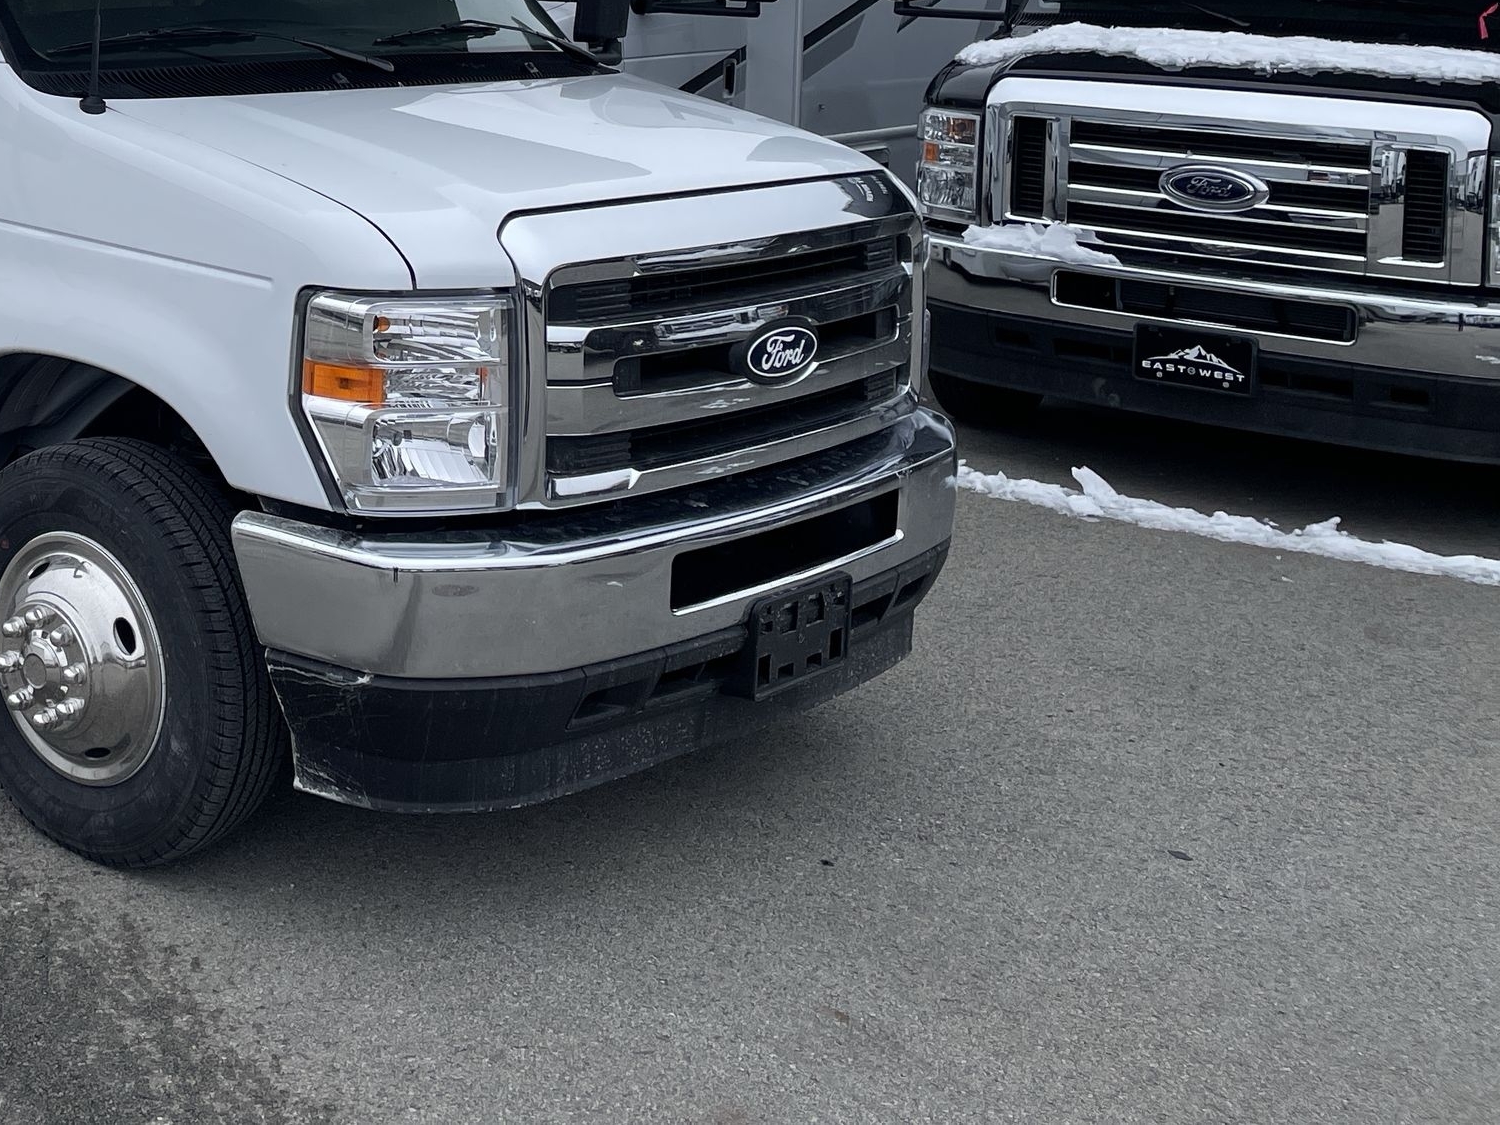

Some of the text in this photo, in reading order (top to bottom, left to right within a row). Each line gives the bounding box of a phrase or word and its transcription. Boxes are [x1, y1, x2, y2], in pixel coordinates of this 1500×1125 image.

[1187, 176, 1233, 197] Ford
[761, 334, 805, 371] Ford
[1141, 359, 1245, 383] EAST WEST
